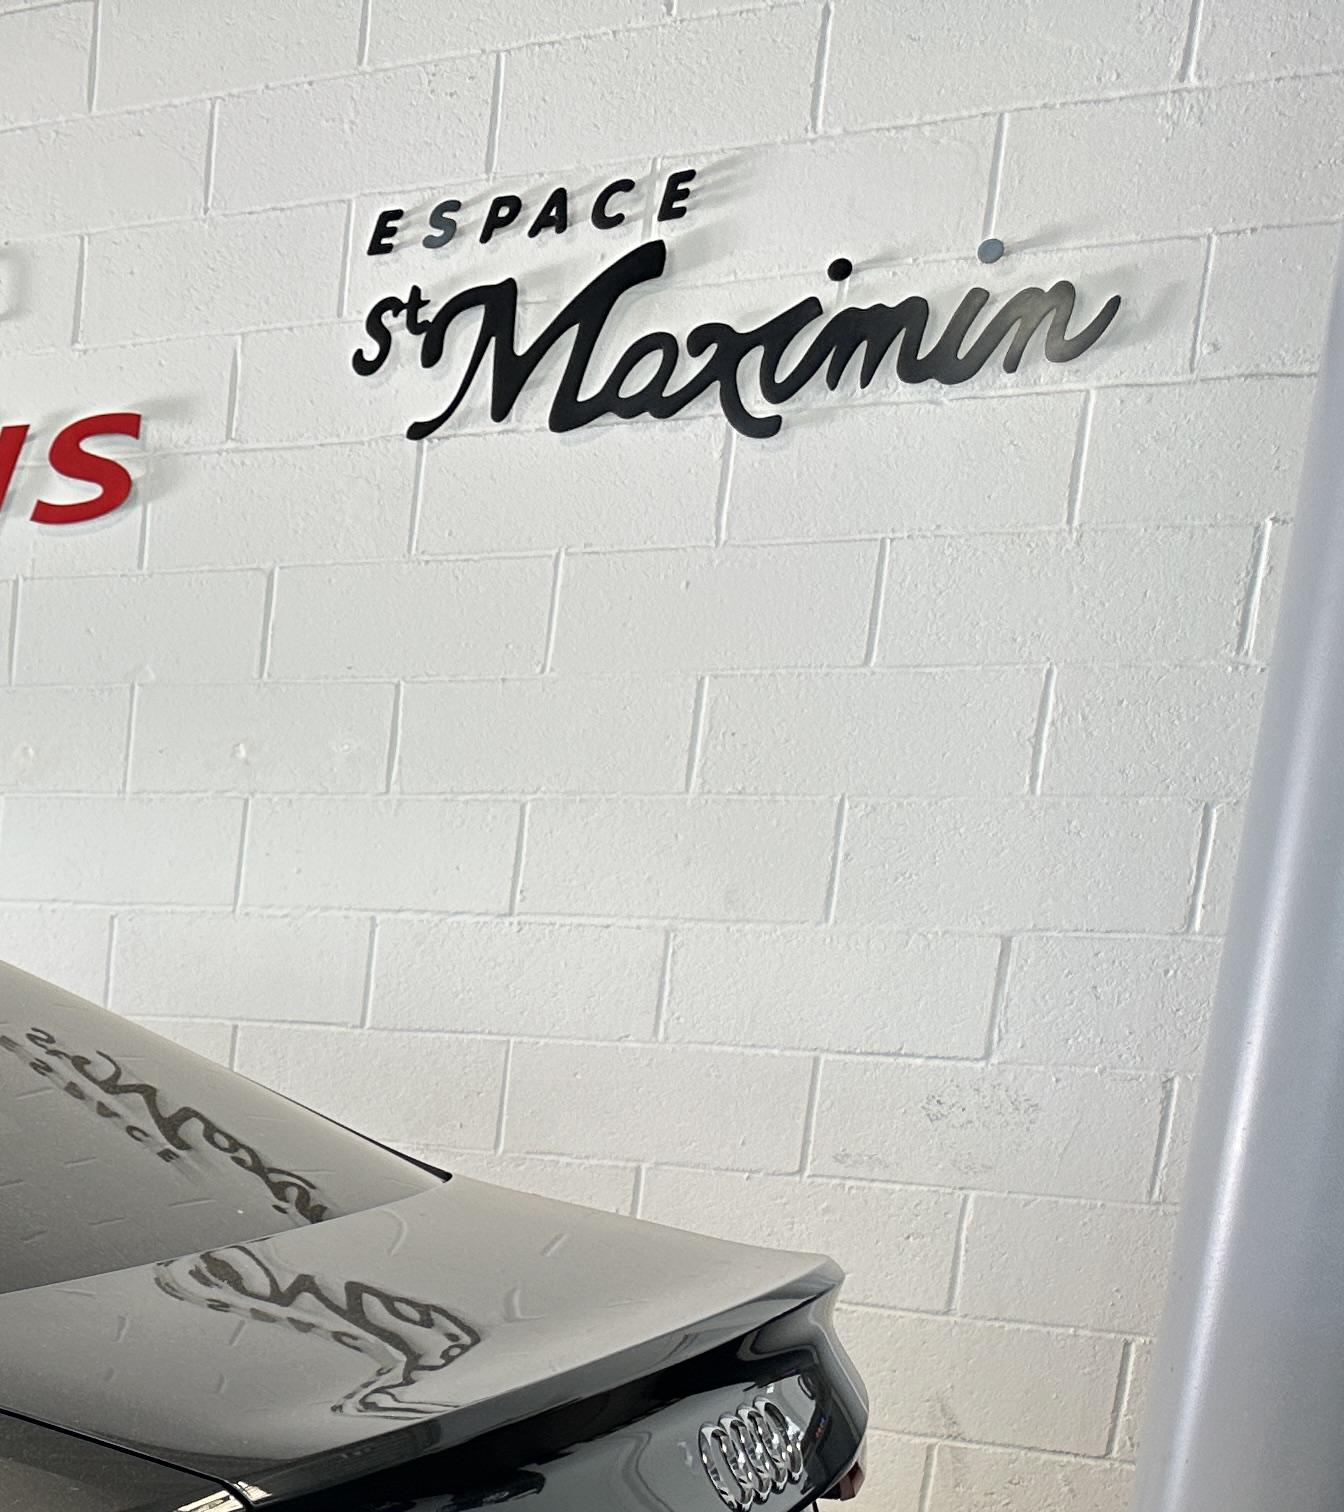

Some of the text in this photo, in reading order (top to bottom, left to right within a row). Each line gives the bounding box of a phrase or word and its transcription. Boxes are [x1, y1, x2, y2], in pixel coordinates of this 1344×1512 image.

[367, 168, 698, 257] ESPACE
[352, 238, 1123, 442] St Maximin
